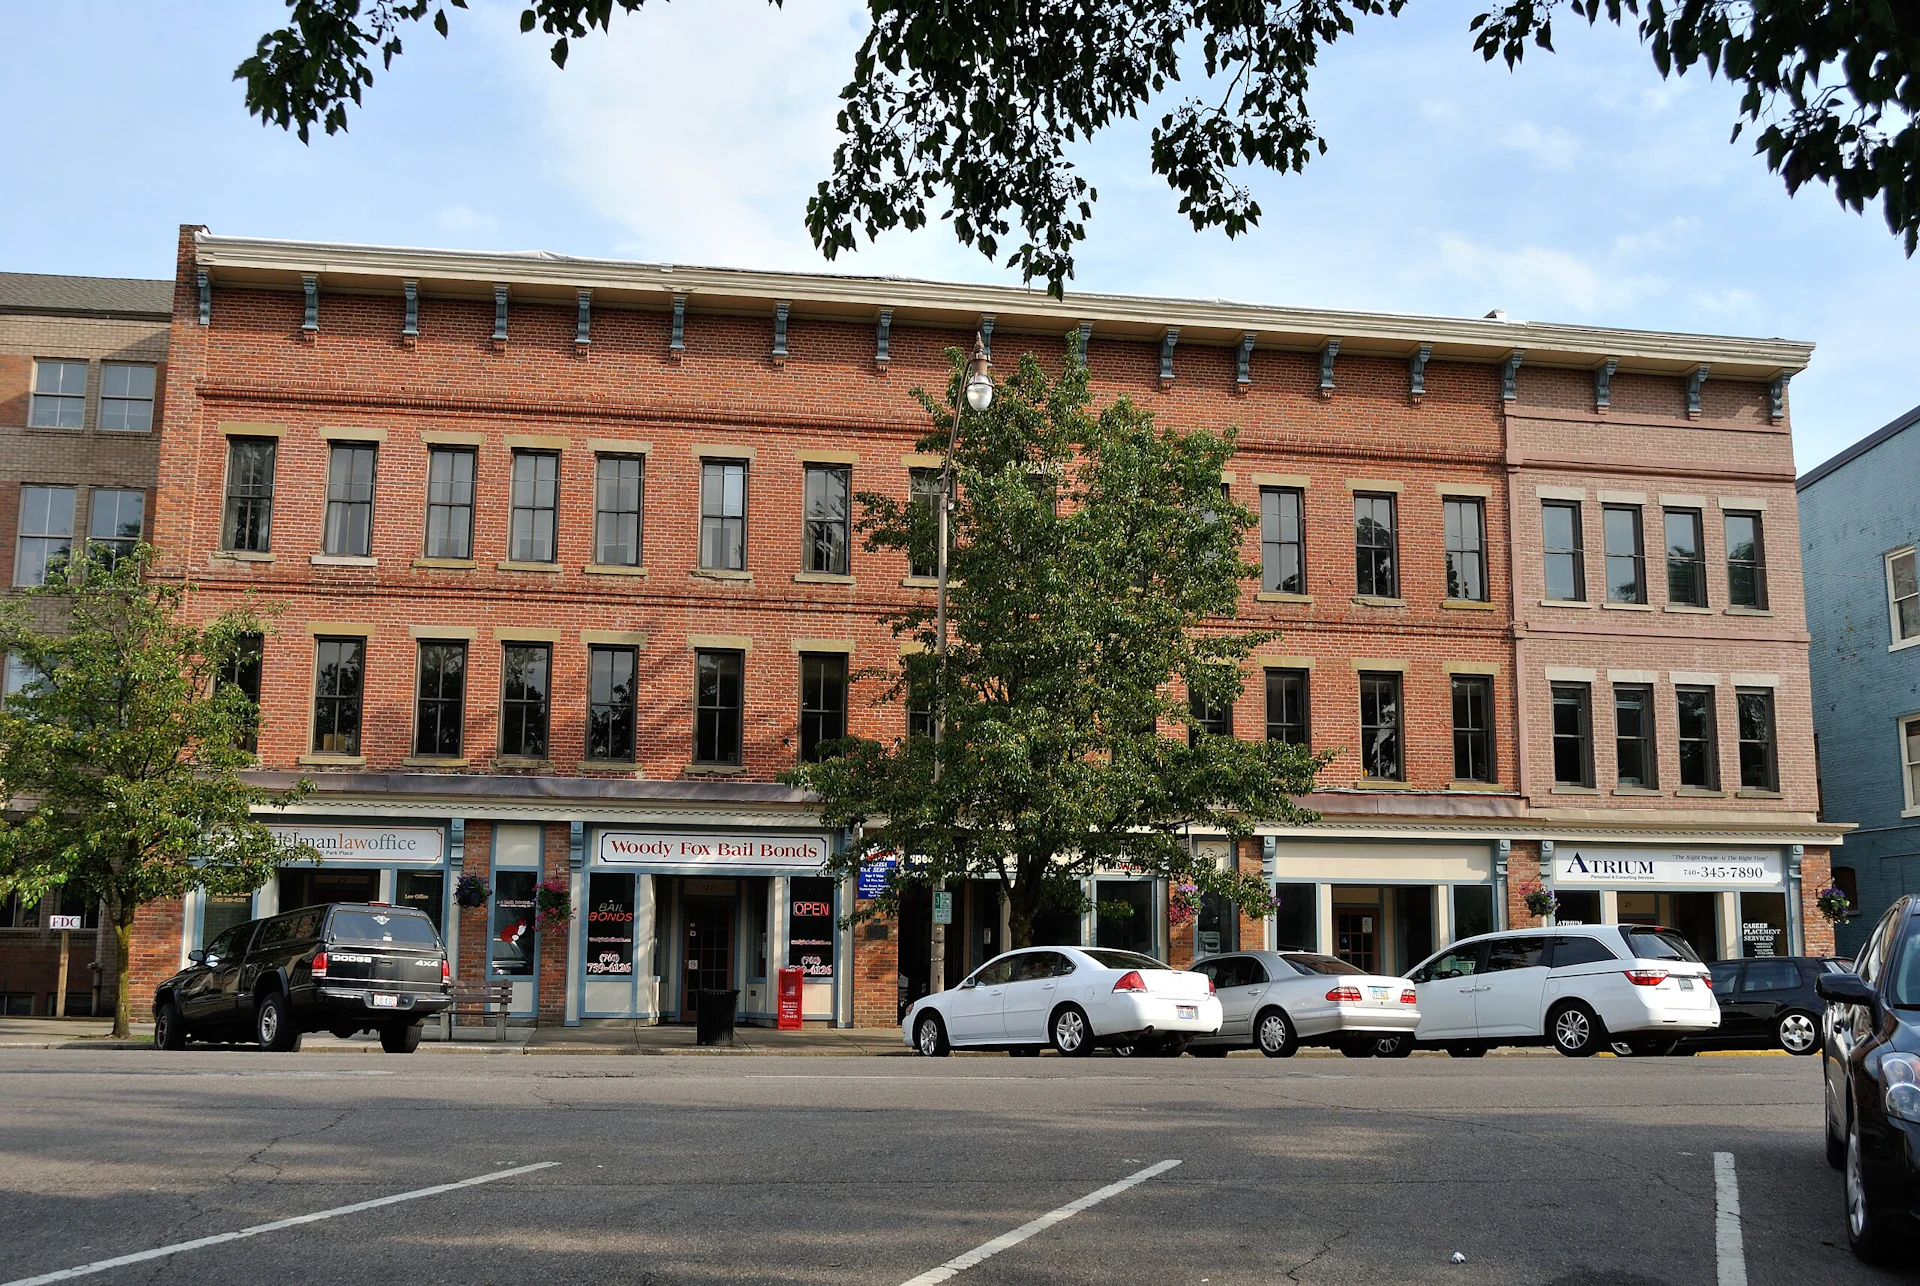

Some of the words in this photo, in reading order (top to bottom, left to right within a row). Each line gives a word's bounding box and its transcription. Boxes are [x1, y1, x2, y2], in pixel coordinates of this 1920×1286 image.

[611, 840, 674, 858] Woody
[680, 841, 711, 856] Fox
[717, 842, 754, 856] Bail
[760, 843, 818, 859] Bonds
[1566, 851, 1655, 874] ATRIUM
[599, 903, 624, 912] BAIL
[795, 902, 829, 916] OPEN
[52, 916, 80, 928] FDC
[589, 911, 633, 922] BONDS
[332, 954, 372, 963] DODGE
